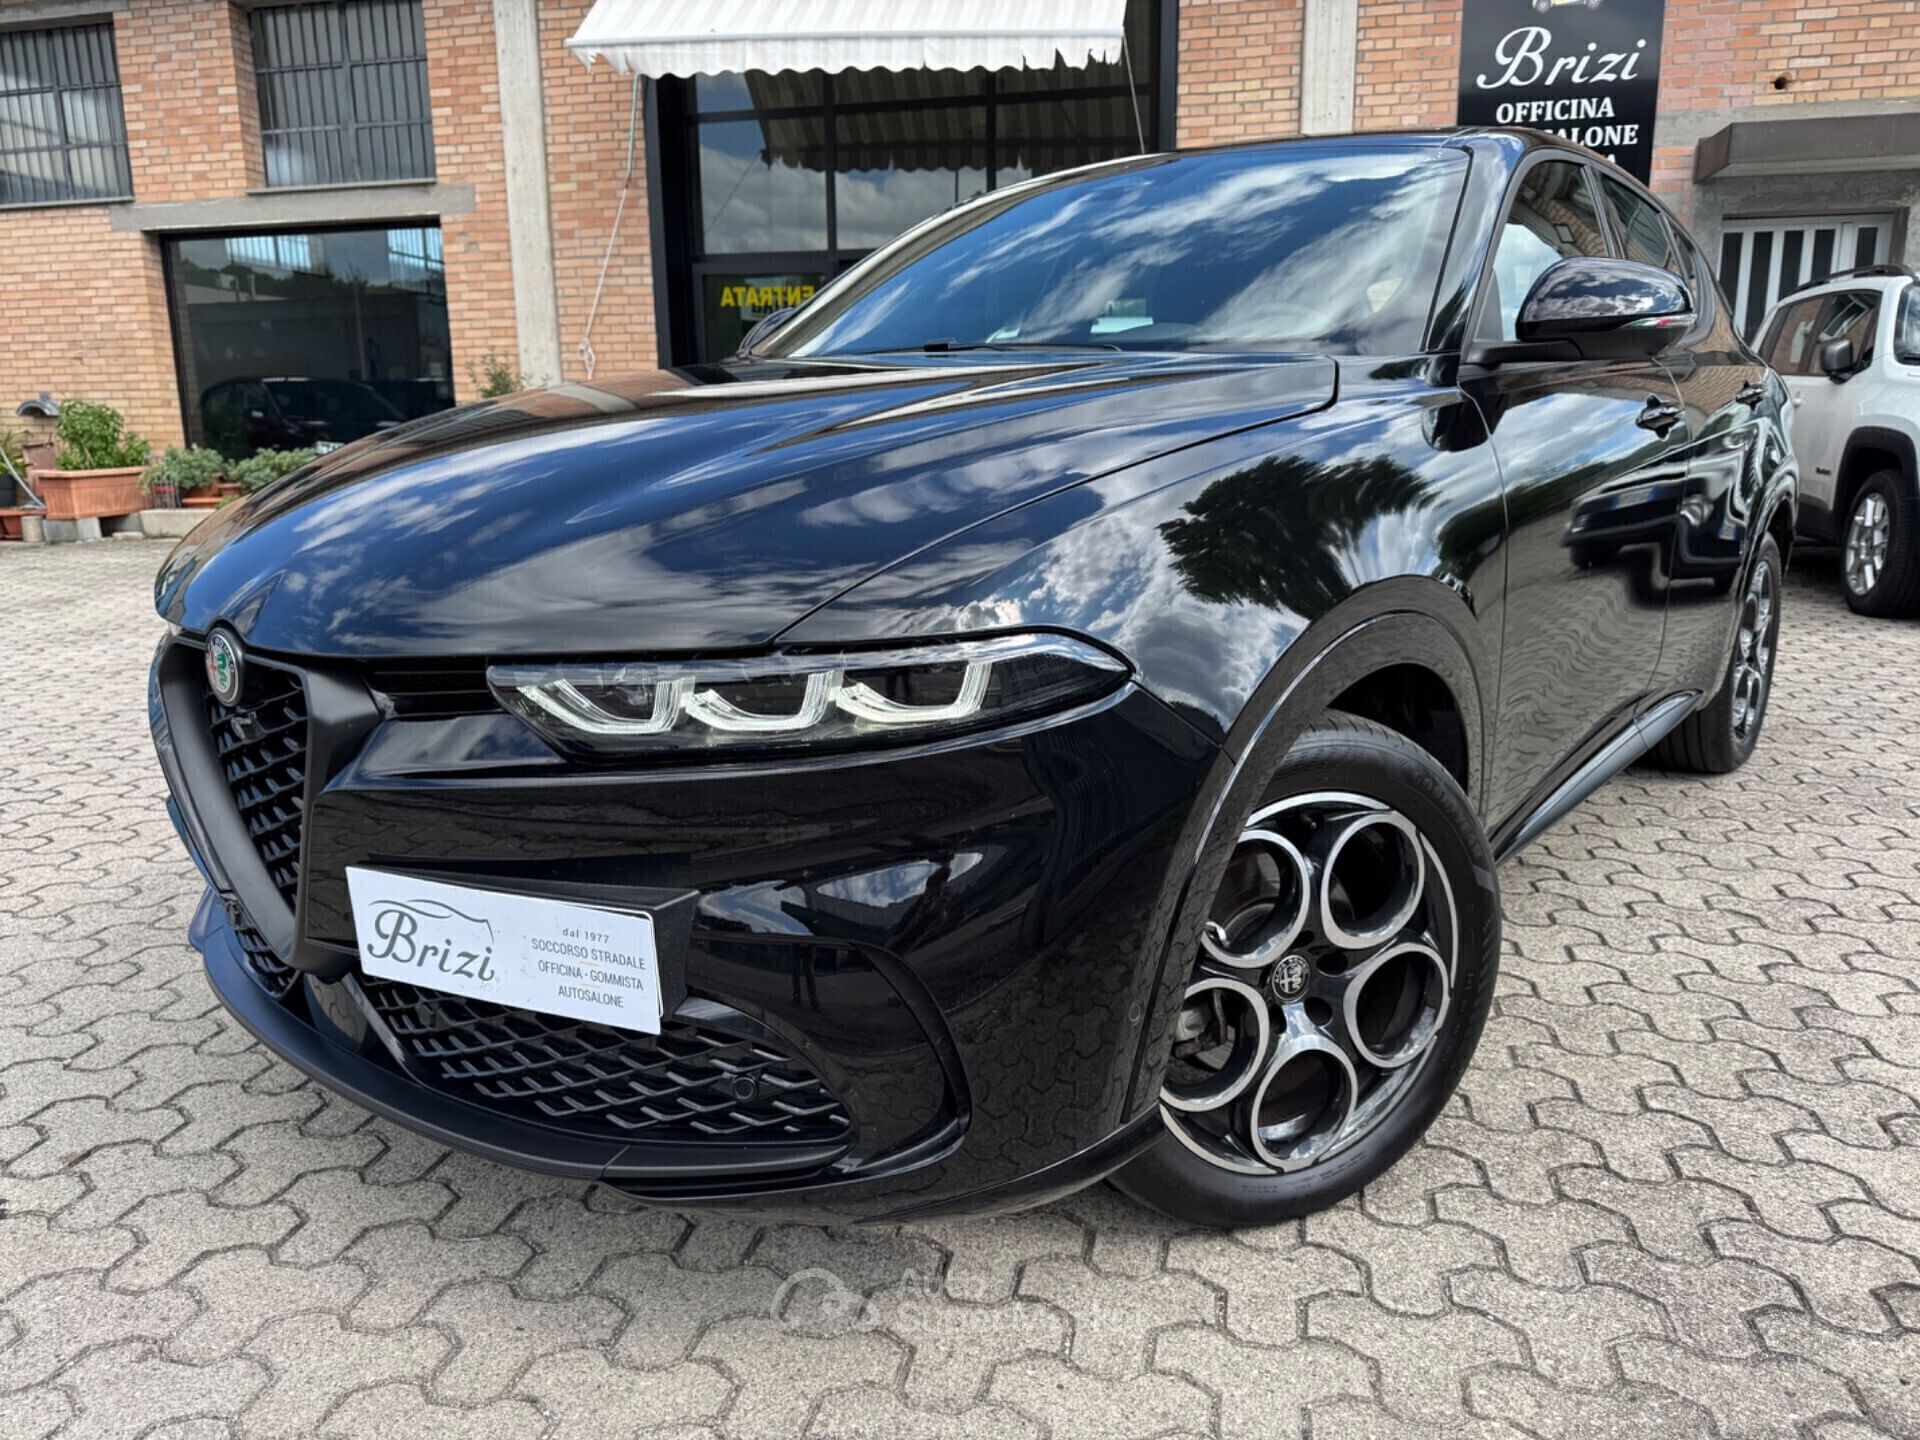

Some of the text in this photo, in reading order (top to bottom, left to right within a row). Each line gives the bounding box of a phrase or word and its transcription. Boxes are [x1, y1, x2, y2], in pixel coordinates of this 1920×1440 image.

[1476, 26, 1647, 89] Brizi
[1496, 97, 1615, 124] OFFICINA
[1544, 124, 1639, 147] ALONE
[367, 909, 495, 981] Brizi
[562, 928, 610, 944] dal 1977
[531, 938, 646, 970] SOCCORSO STRADALE
[538, 959, 583, 979] OFFICINA
[589, 969, 644, 991] GOMMISTA
[558, 985, 624, 1008] AUTOSALONE
